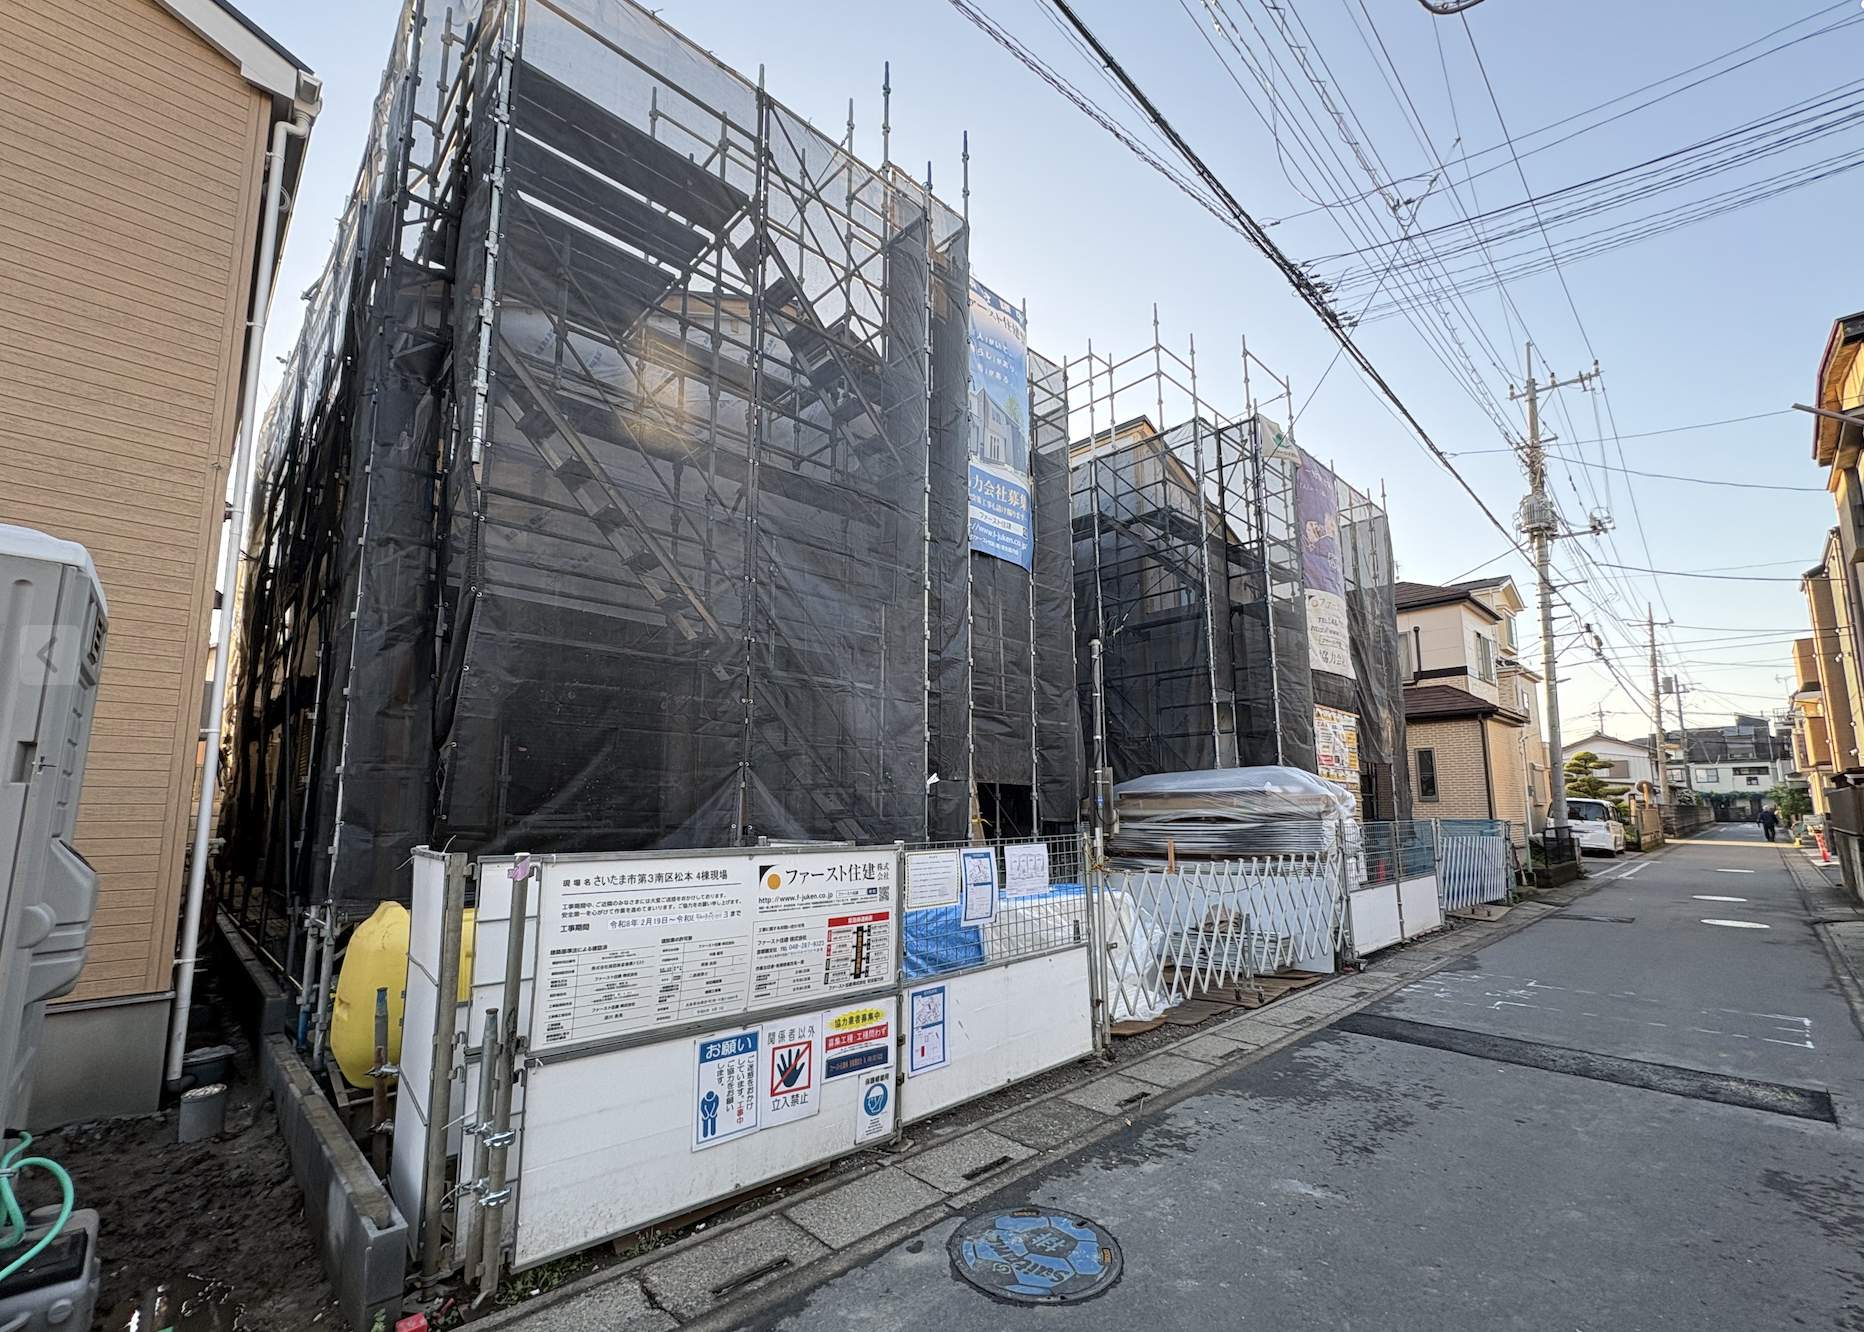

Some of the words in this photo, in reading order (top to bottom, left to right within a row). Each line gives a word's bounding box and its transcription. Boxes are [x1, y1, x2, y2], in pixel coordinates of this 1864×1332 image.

[969, 474, 1028, 513] 力会社募集
[786, 862, 875, 885] ファースト住建
[767, 1026, 816, 1046] 関係者以外
[705, 1037, 752, 1060] お願い
[771, 1092, 809, 1112] 立入禁止
